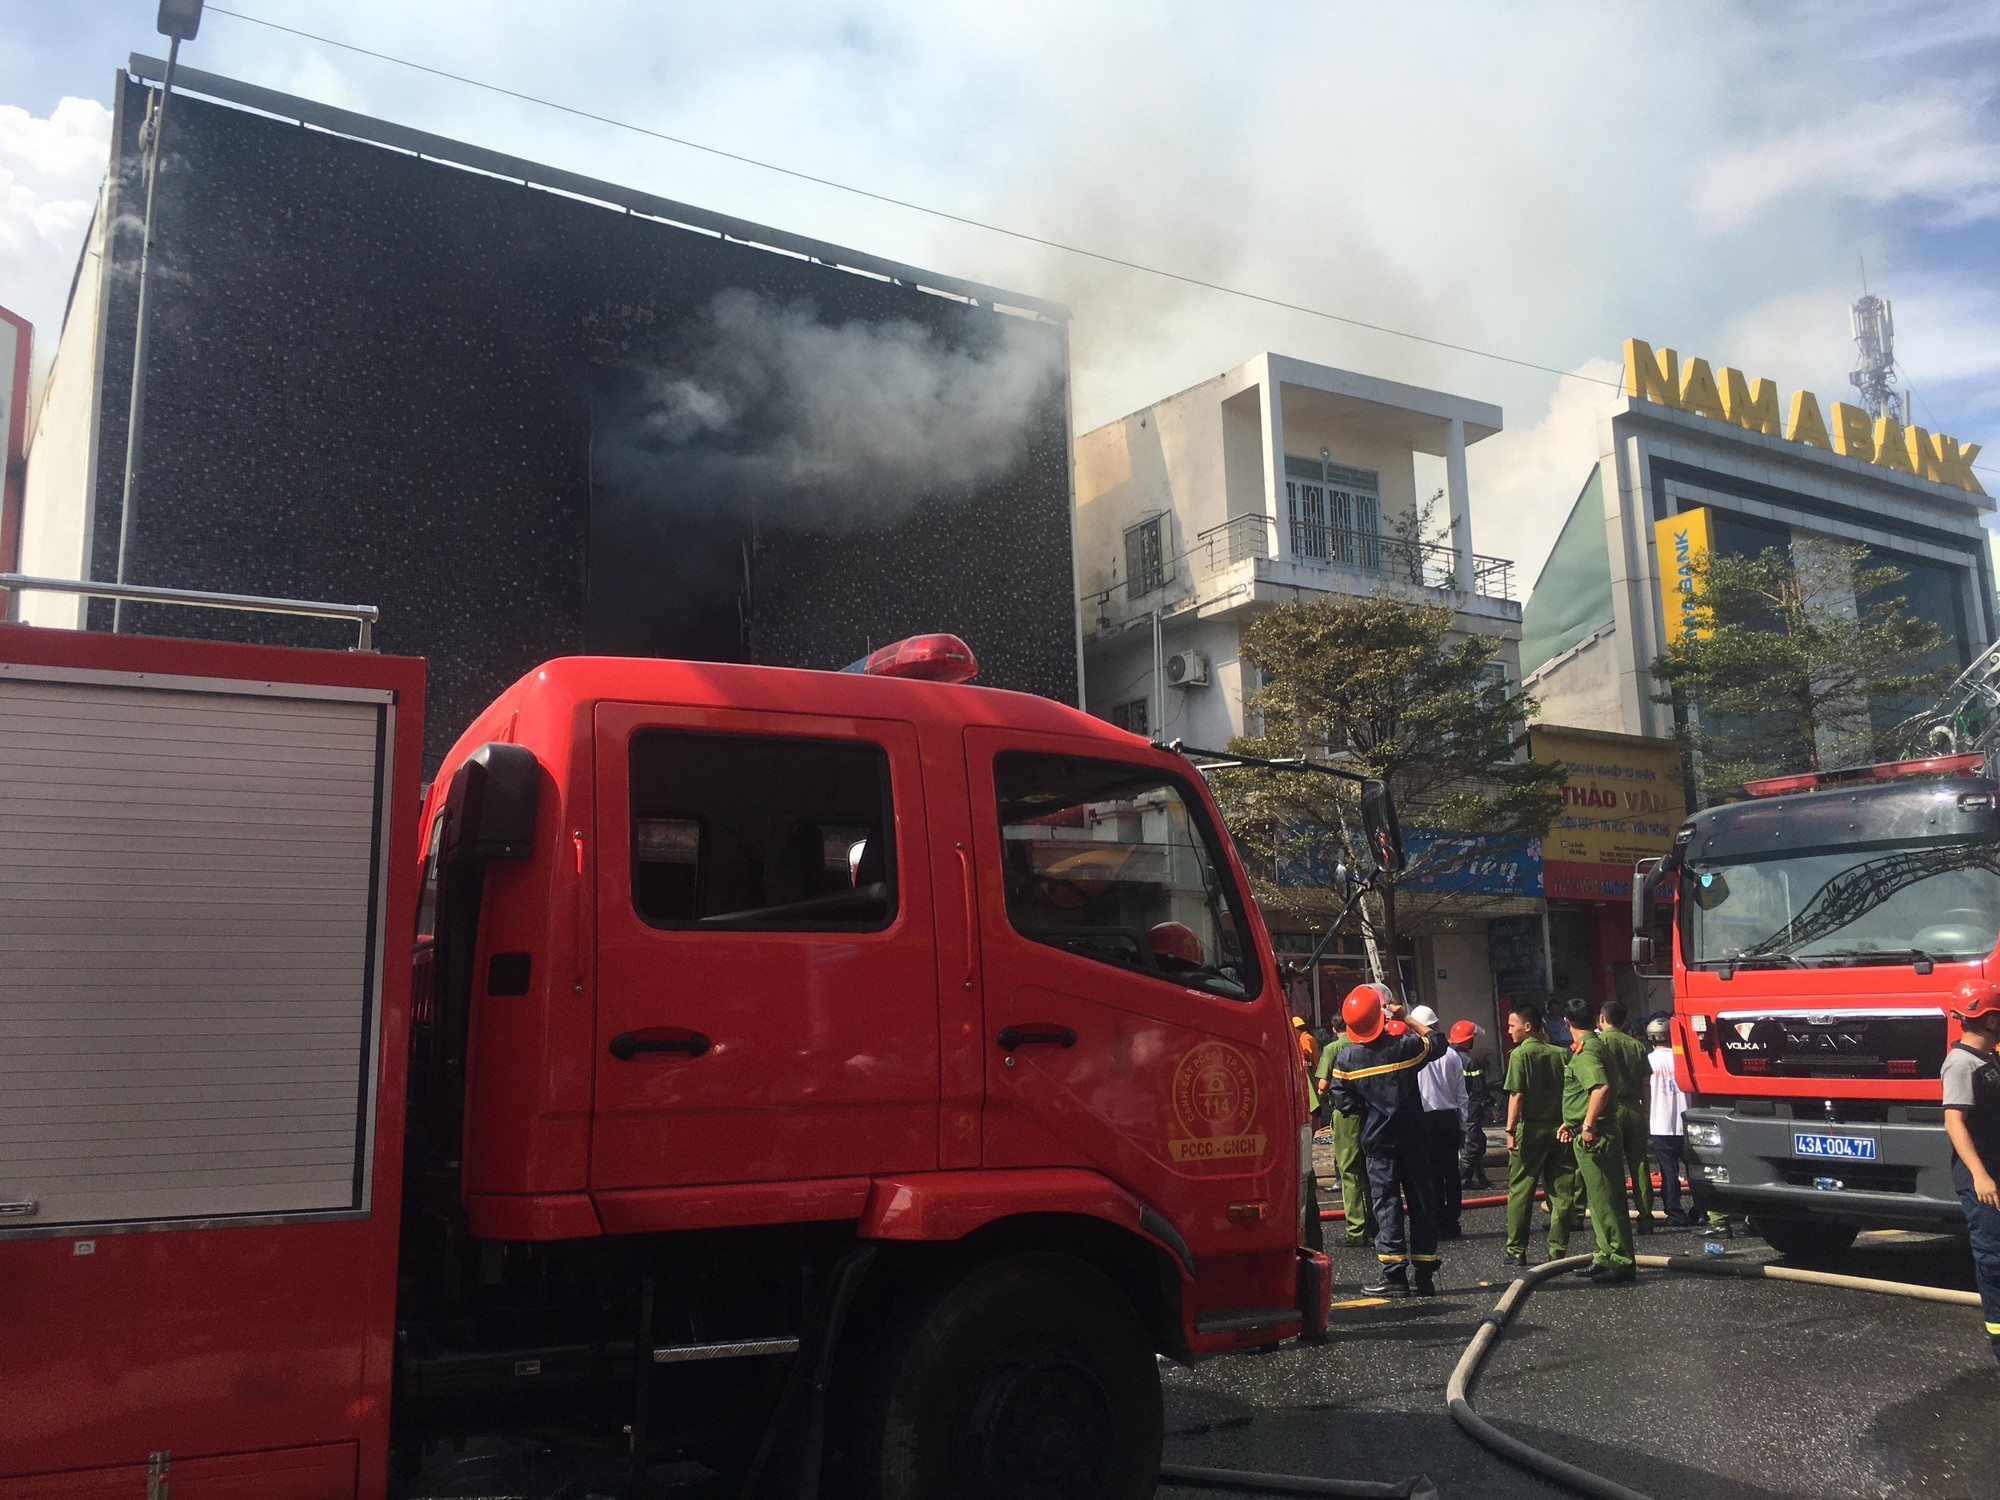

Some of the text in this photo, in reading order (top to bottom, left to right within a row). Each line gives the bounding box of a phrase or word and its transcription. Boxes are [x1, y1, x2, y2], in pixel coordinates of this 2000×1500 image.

[1559, 782, 1617, 809] THẢO
[1203, 1097, 1230, 1116] 114
[1180, 1142, 1214, 1158] PCCC
[1223, 1139, 1256, 1155] CNCH
[1798, 1136, 1872, 1157] 43A-004.77
